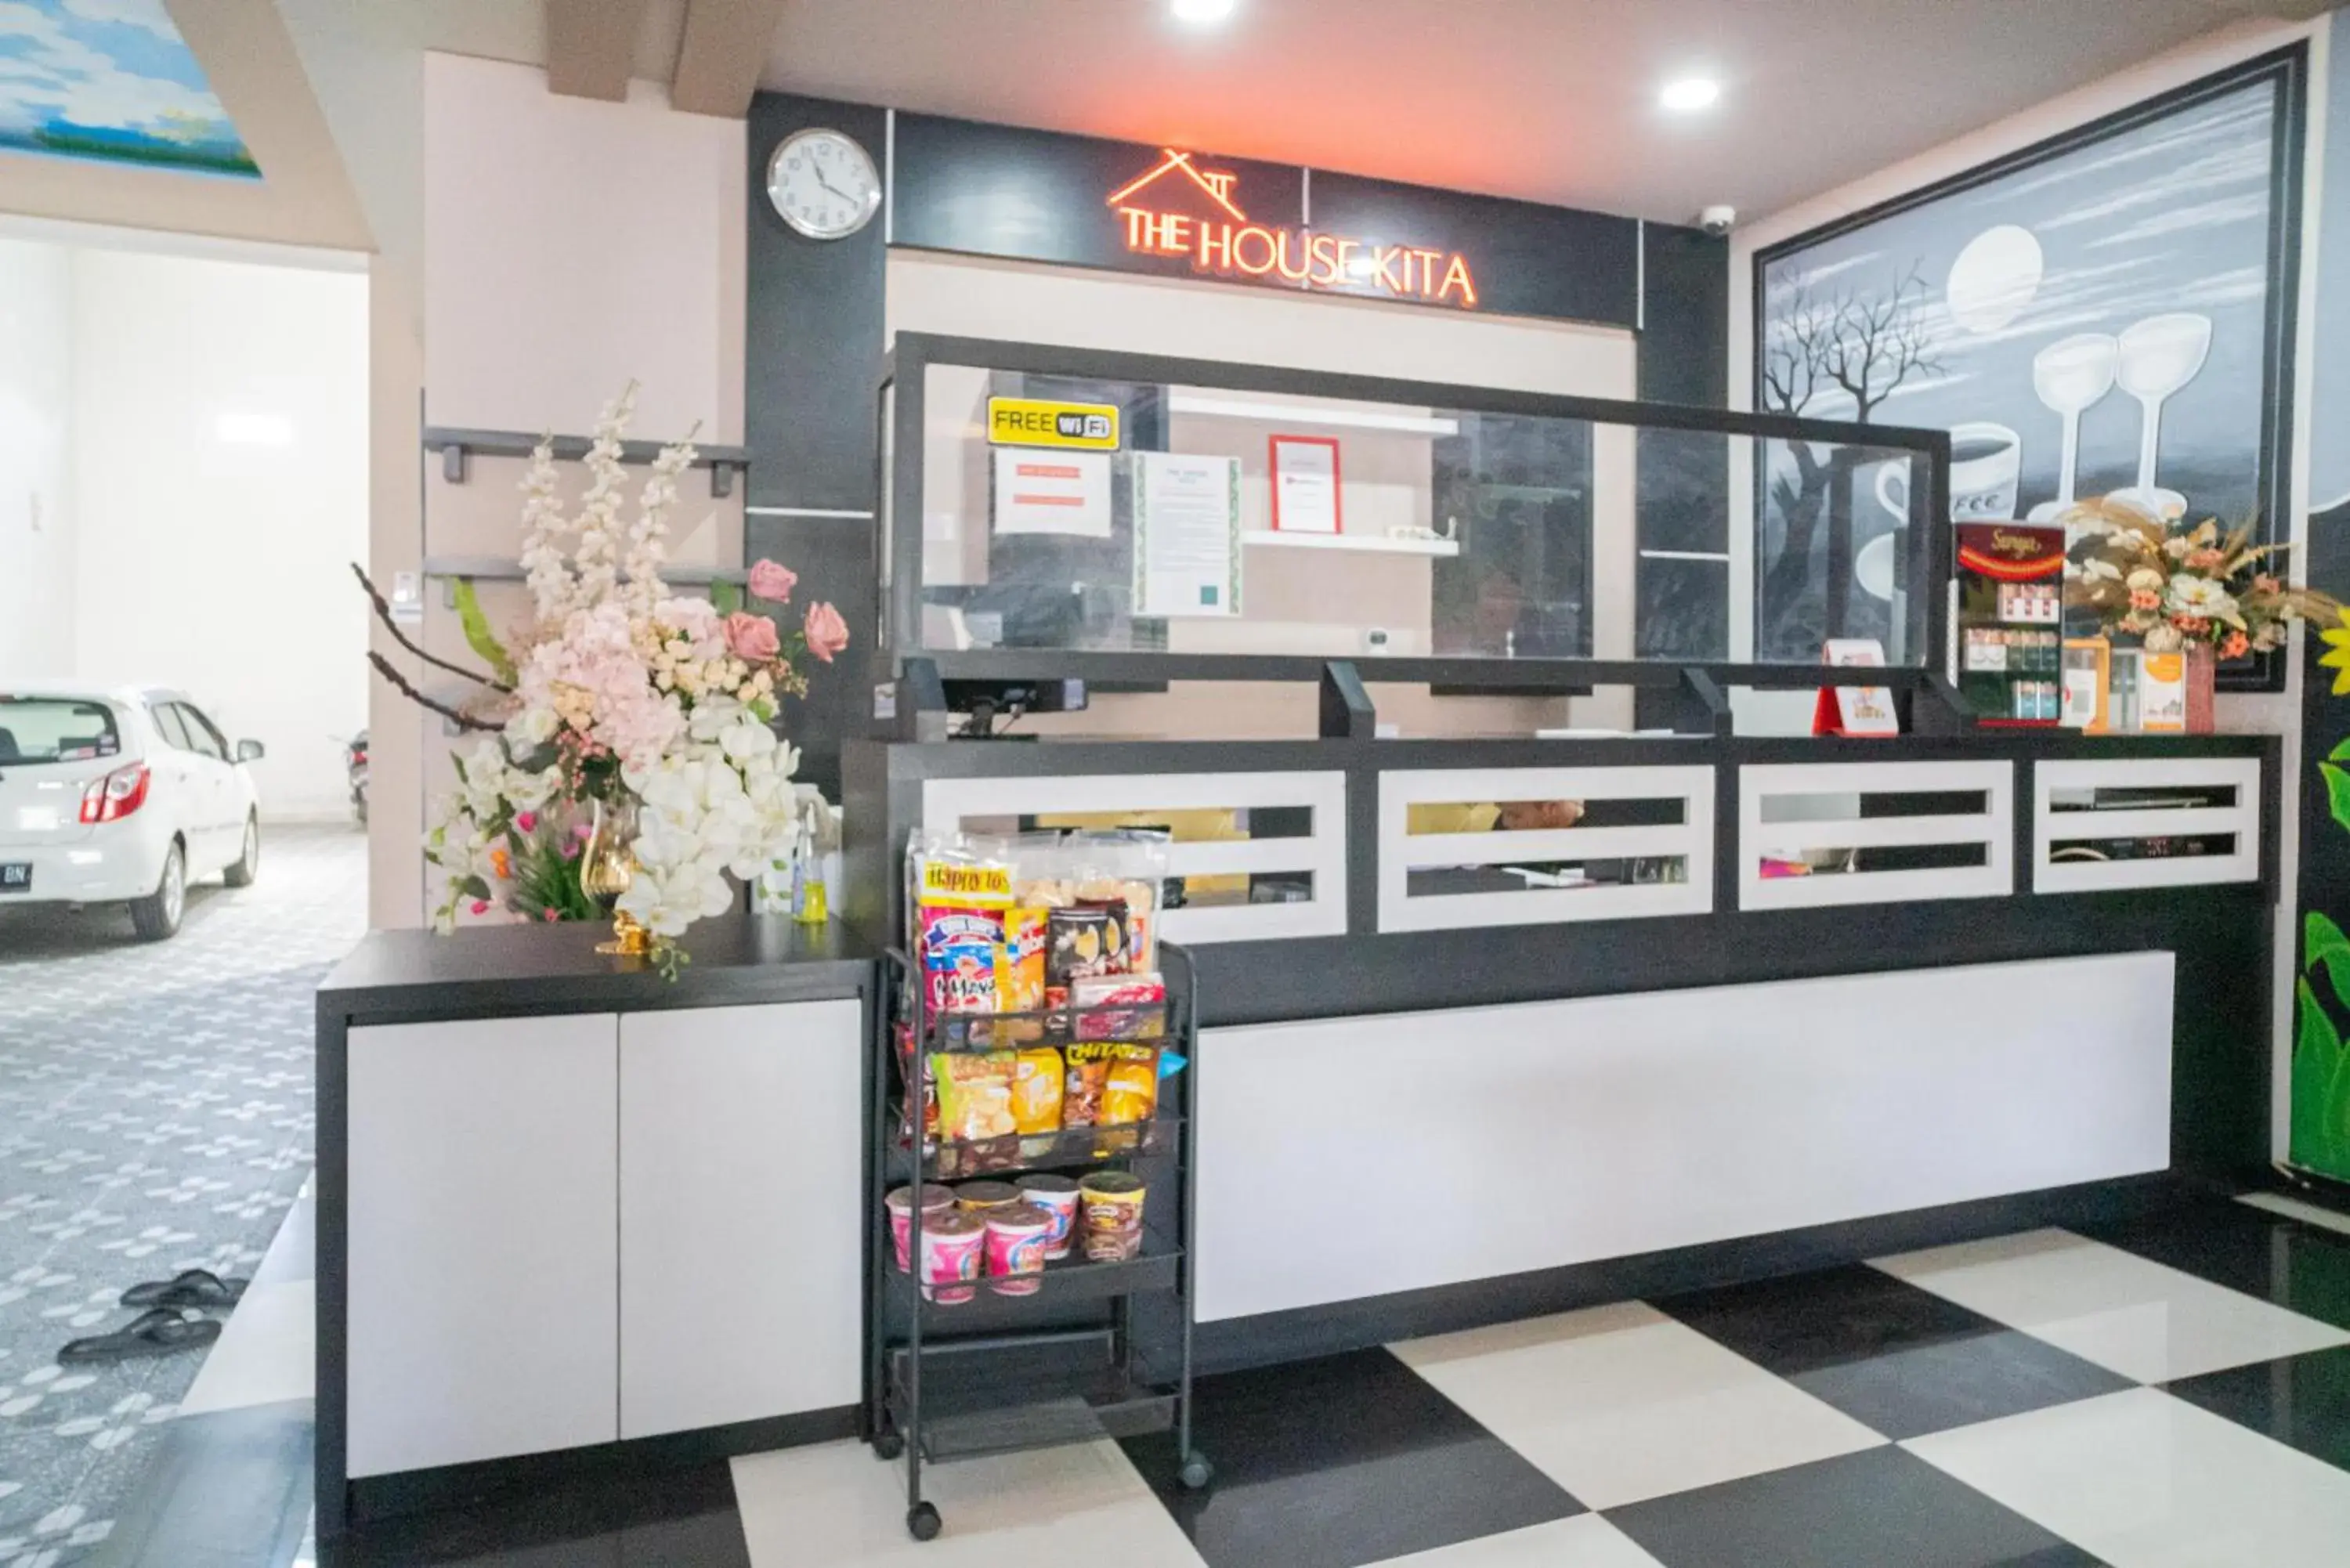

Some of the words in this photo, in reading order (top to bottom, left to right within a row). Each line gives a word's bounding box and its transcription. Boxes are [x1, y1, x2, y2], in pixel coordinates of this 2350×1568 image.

[1119, 206, 1191, 252] THE
[1201, 221, 1361, 285] HOUSE
[1373, 244, 1478, 305] KITA
[994, 410, 1054, 432] FREE
